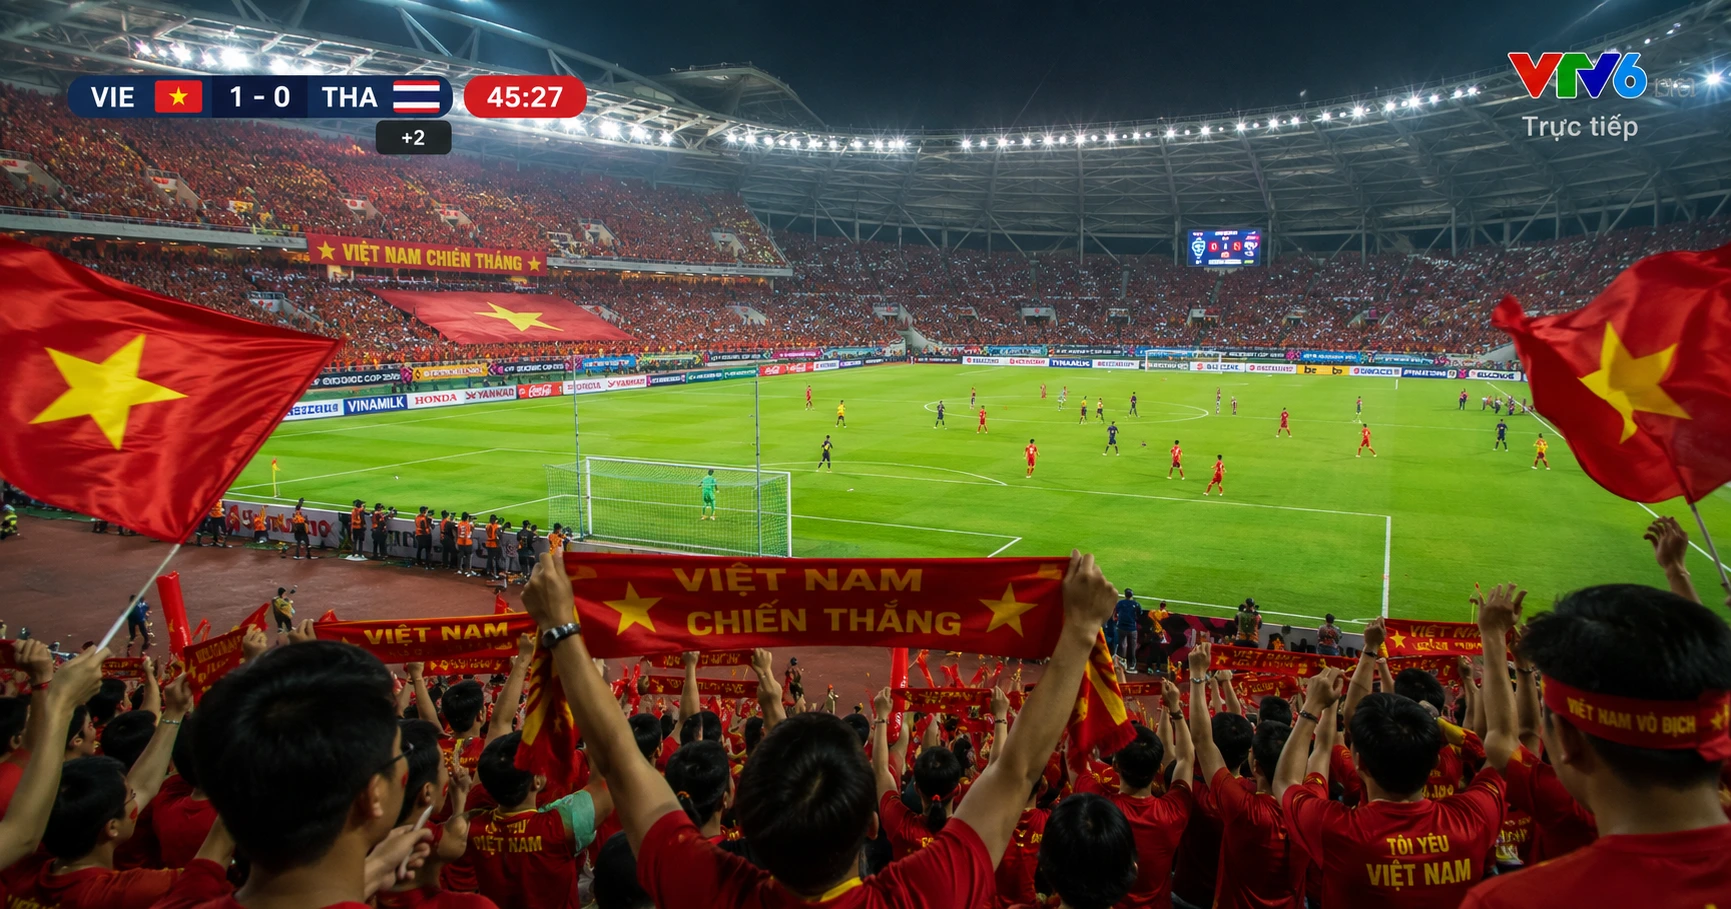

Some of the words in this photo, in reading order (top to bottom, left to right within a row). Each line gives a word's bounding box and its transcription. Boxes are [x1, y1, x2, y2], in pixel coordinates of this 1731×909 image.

[342, 240, 380, 266] VIỆT
[385, 246, 422, 265] NAM
[348, 396, 404, 412] VINAMILK
[415, 393, 457, 405] HONDA
[674, 562, 786, 597] VIỆT
[804, 568, 923, 592] NAM
[687, 599, 807, 636] CHIẾN
[823, 599, 961, 636] THẮNG
[363, 624, 431, 647] VIỆT
[441, 622, 508, 641] NAM
[1598, 708, 1632, 730] NAM
[508, 836, 543, 852] NAM
[1386, 834, 1414, 856] TÔI
[1416, 832, 1450, 854] YÊU
[1365, 859, 1416, 891] VIỆT
[1423, 858, 1471, 886] NAM
